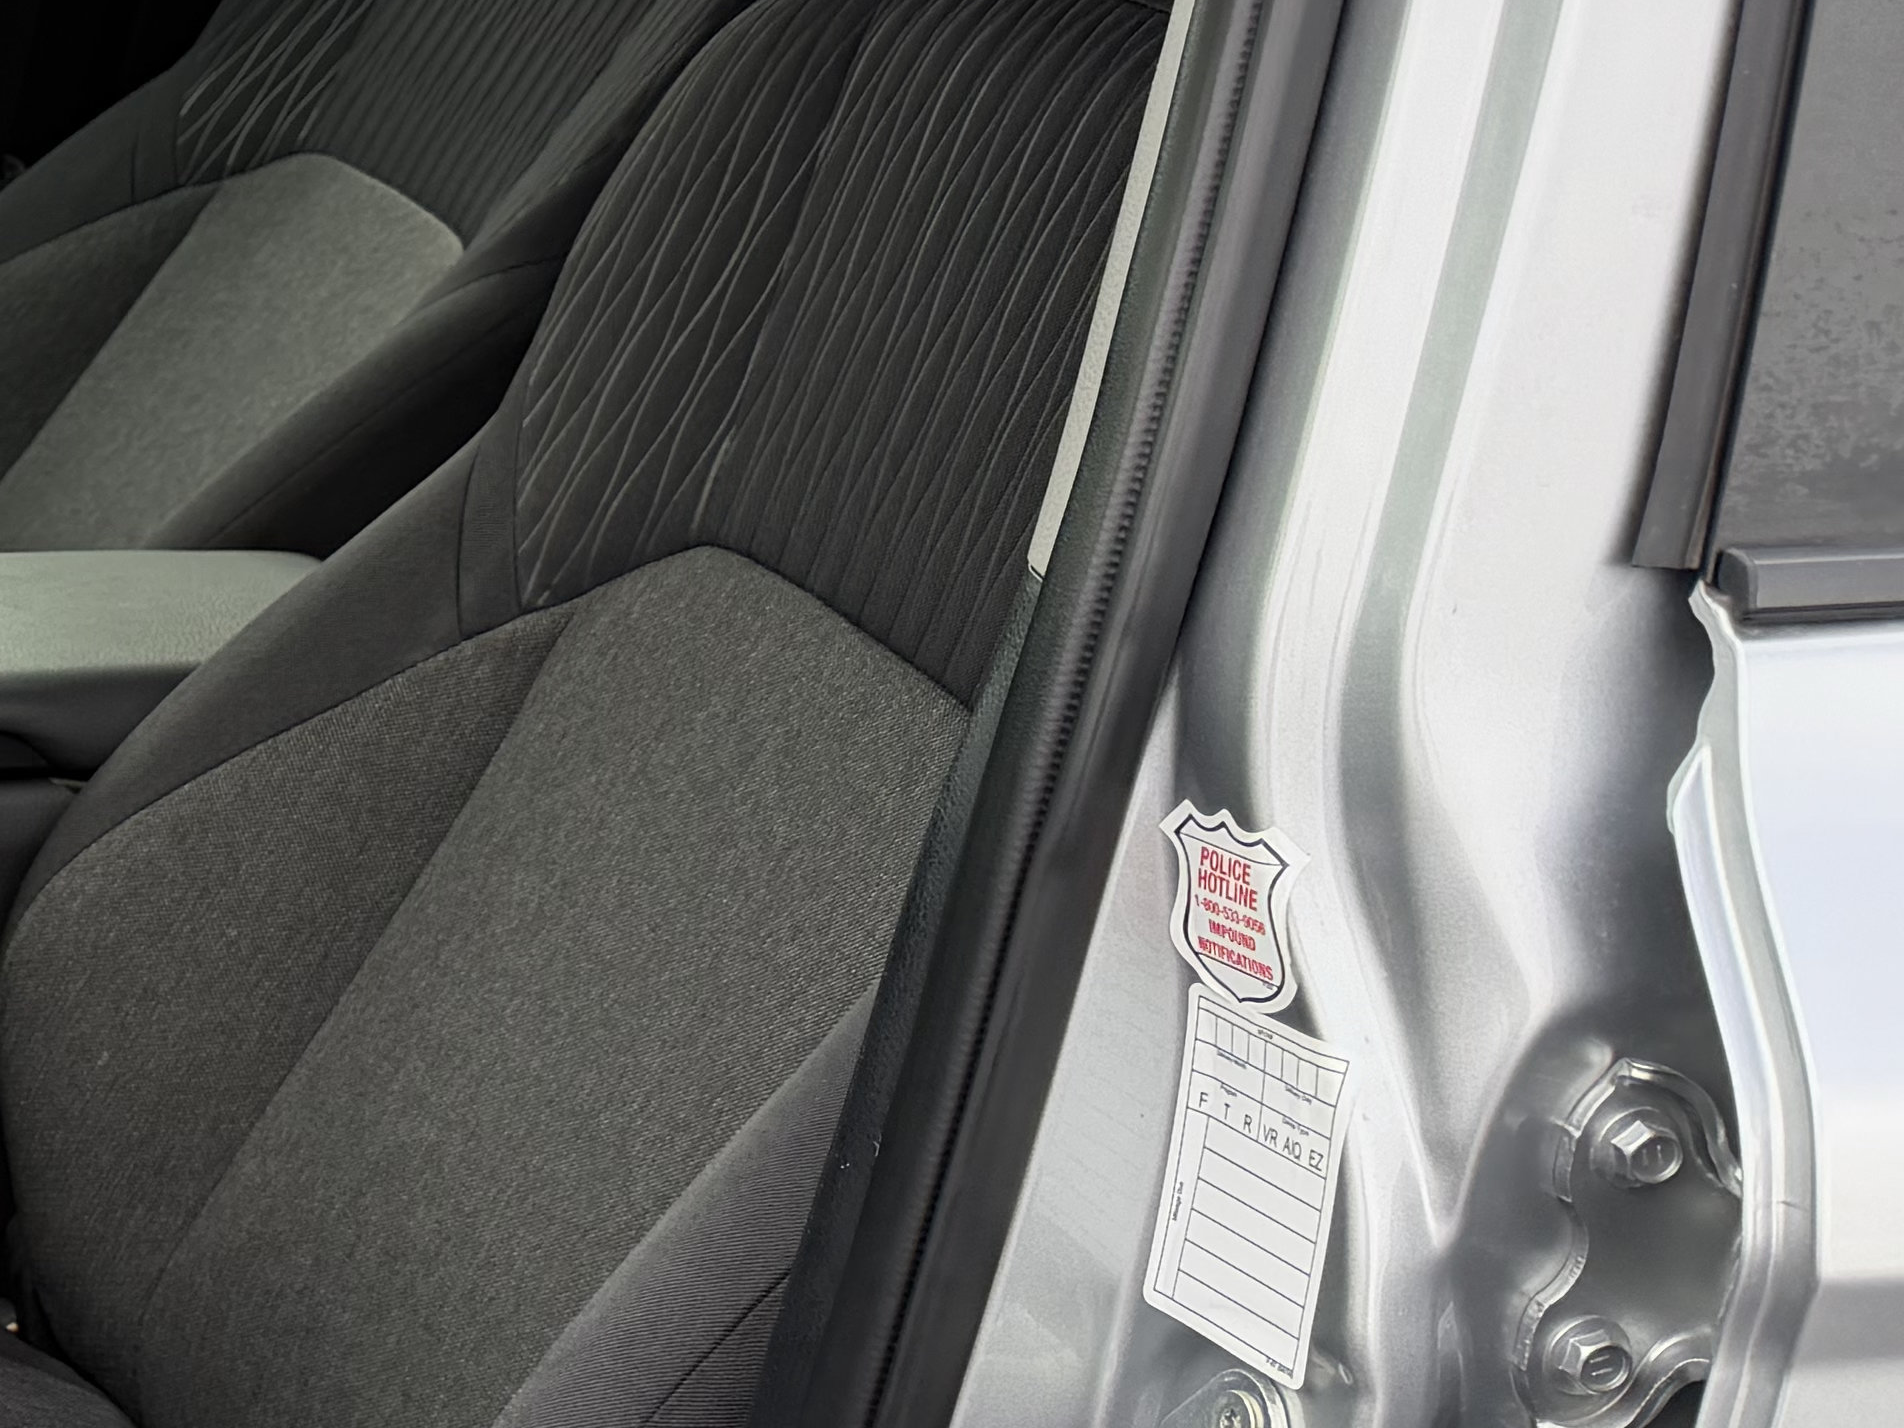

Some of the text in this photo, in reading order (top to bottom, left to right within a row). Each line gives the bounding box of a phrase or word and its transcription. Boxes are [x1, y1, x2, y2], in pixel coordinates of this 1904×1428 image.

[1200, 846, 1251, 885] POLICE
[1198, 868, 1258, 911] HOTLINE
[1208, 919, 1256, 951] IMPOUND
[1198, 936, 1273, 980] NOTIFICATIONS
[1198, 1090, 1208, 1110] F
[1221, 1102, 1231, 1121] T
[1242, 1112, 1253, 1133] R
[1261, 1123, 1279, 1148] VR
[1307, 1148, 1324, 1171] EZ
